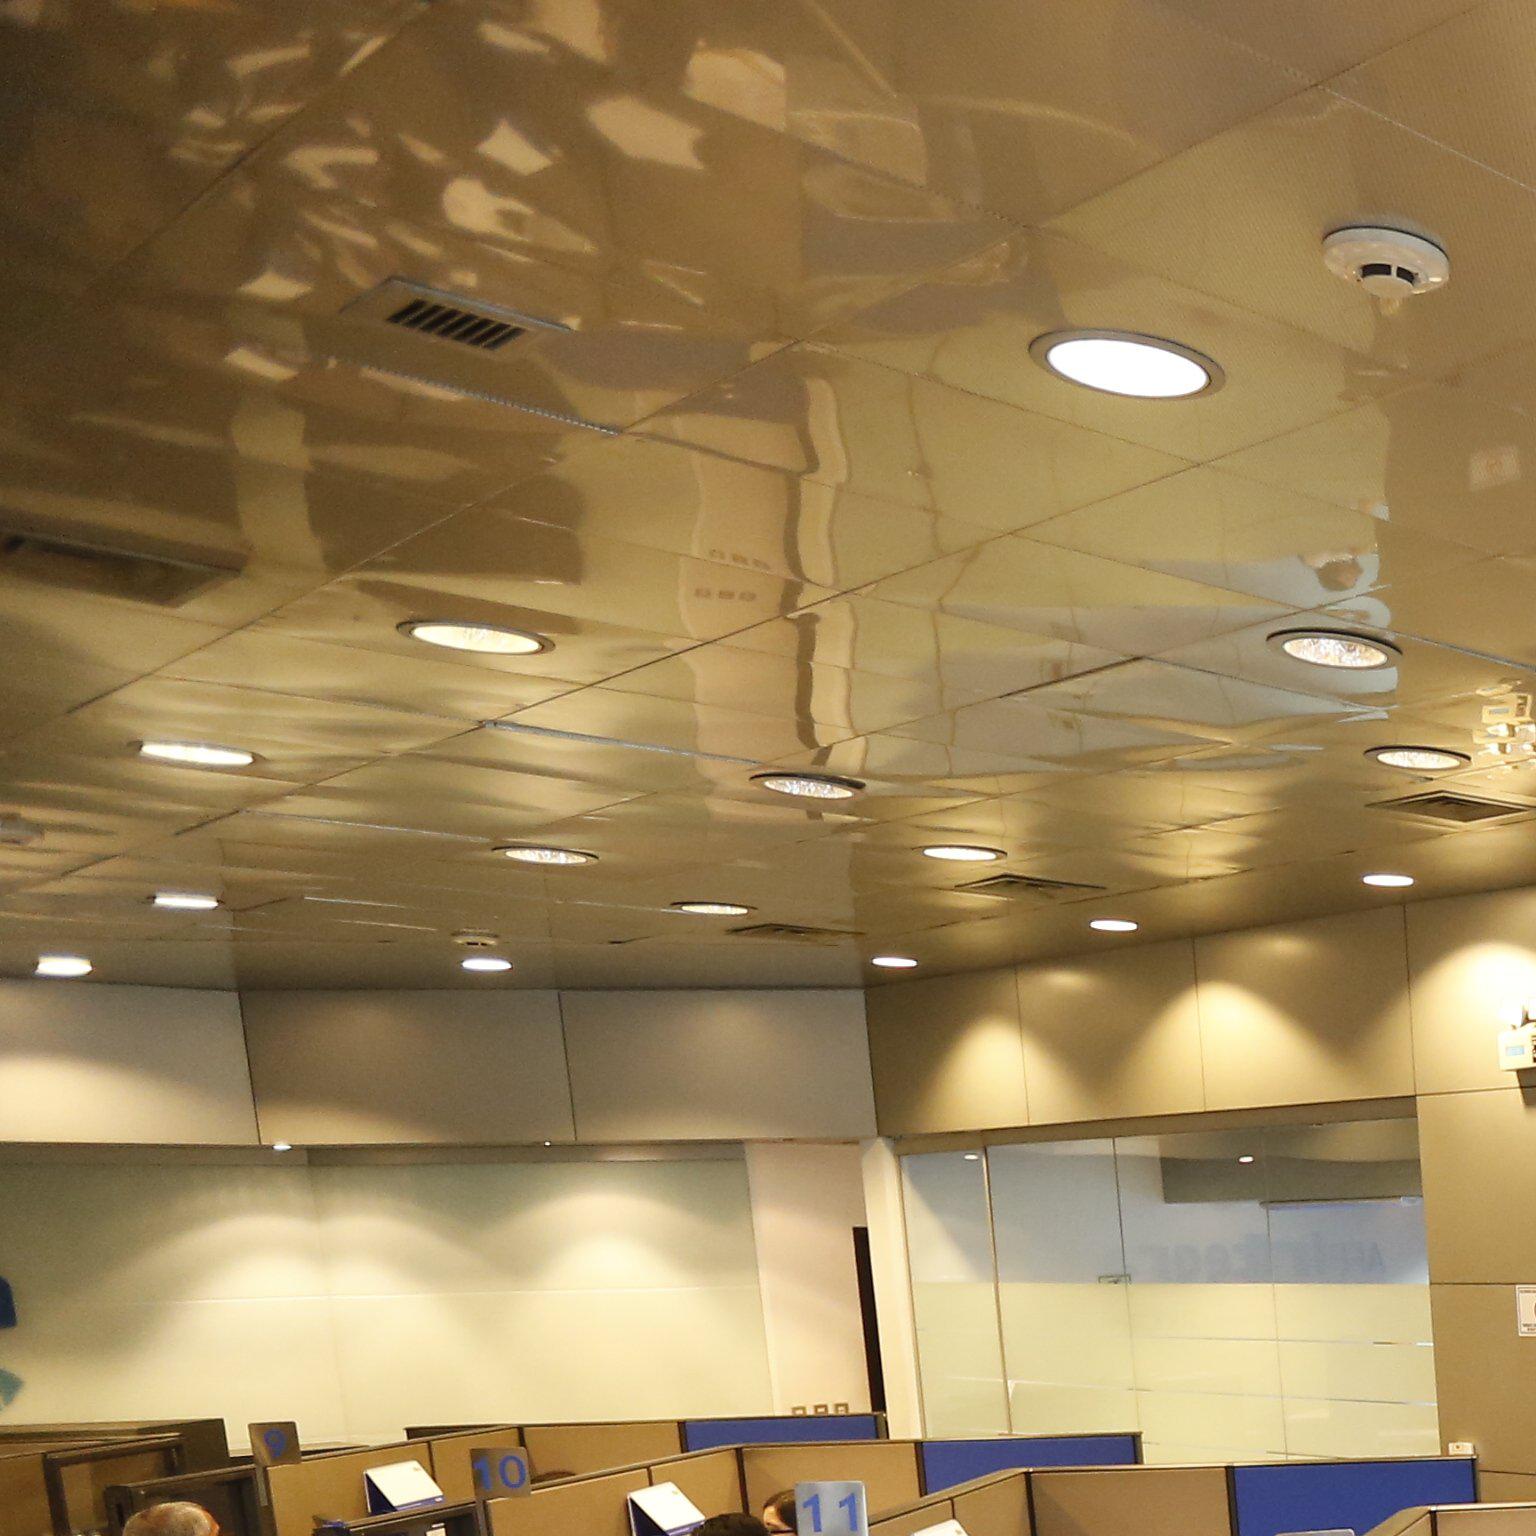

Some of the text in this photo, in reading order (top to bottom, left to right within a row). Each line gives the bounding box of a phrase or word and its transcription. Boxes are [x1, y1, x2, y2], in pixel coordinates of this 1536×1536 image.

[264, 1428, 285, 1458] 9
[474, 1455, 526, 1490] 10
[802, 1492, 862, 1533] 11
